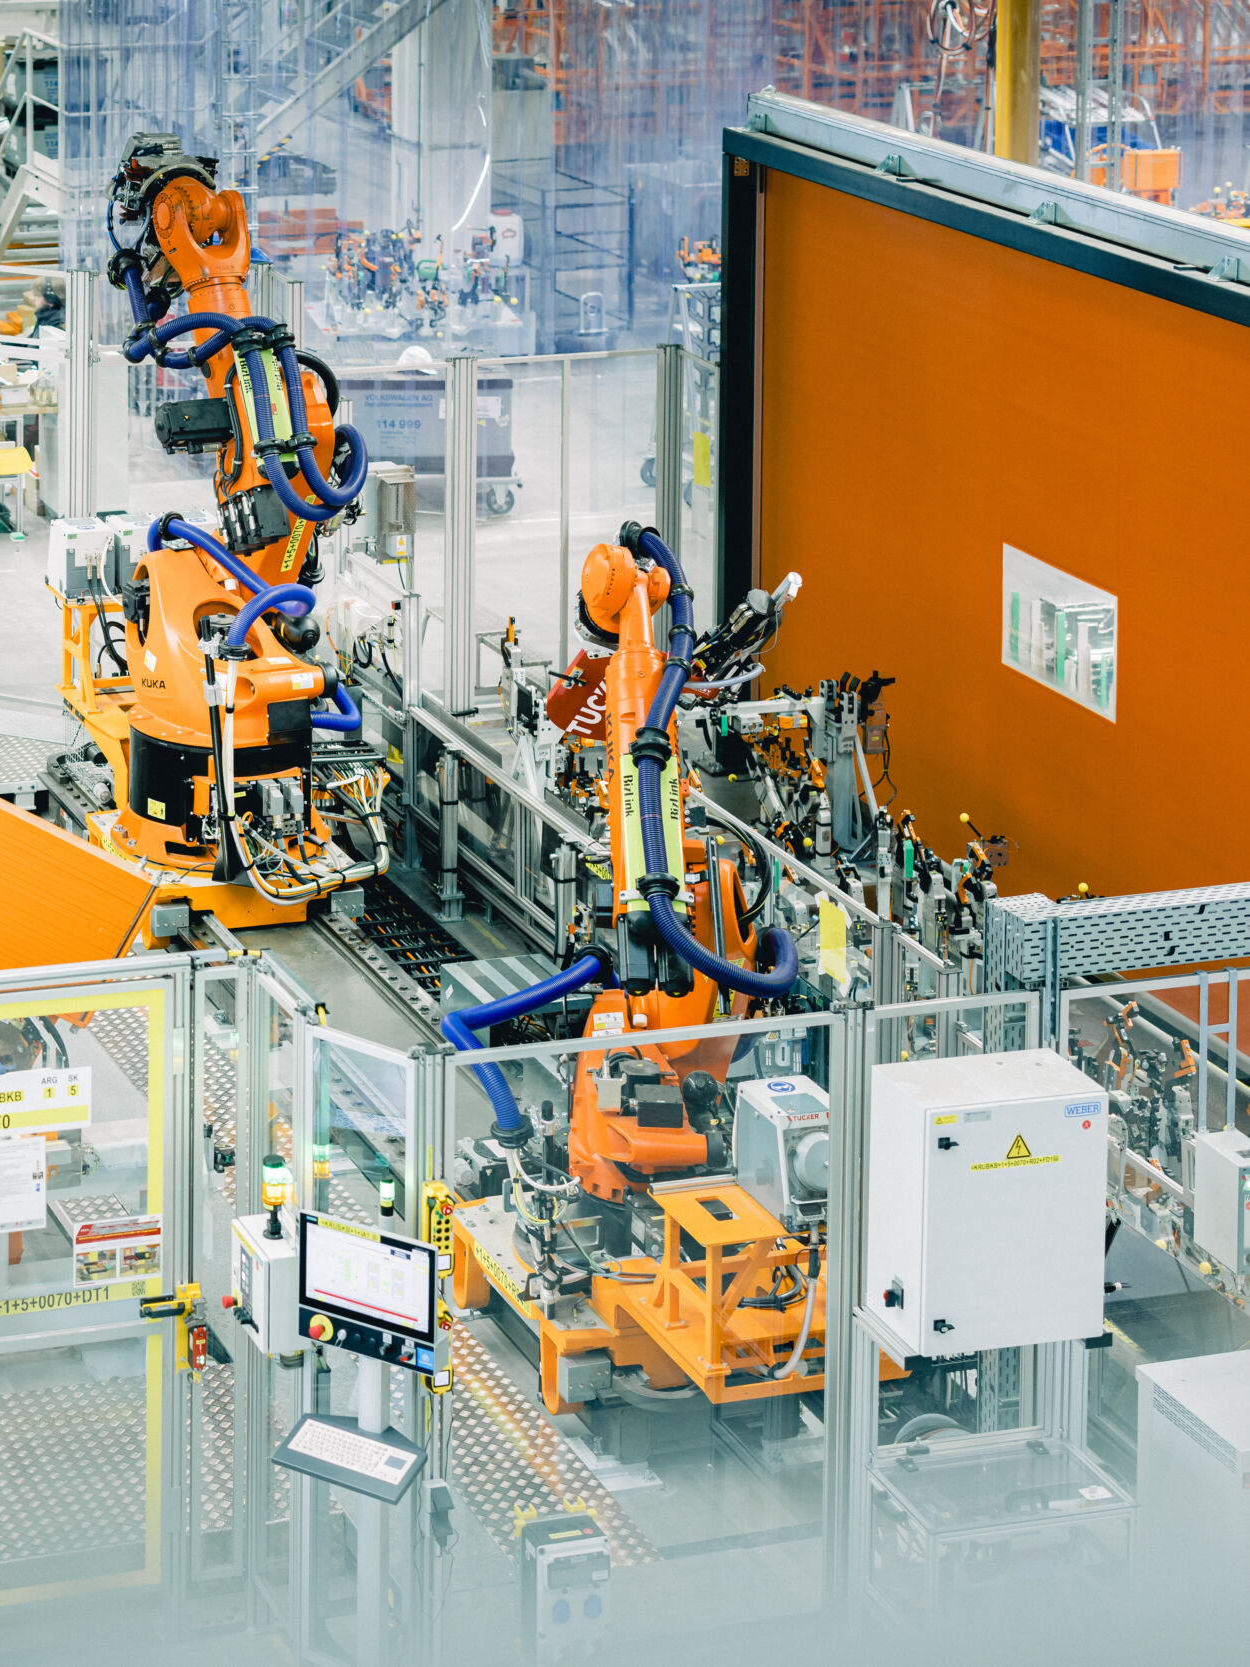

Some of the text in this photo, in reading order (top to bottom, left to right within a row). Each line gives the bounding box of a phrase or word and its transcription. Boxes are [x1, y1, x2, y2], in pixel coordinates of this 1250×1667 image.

[142, 678, 166, 690] KUKA
[623, 774, 635, 817] BizLink
[41, 1074, 79, 1085] ARG SK
[70, 1086, 76, 1096] 5
[1066, 1103, 1099, 1116] WEBER
[793, 1113, 819, 1121] TUCKER
